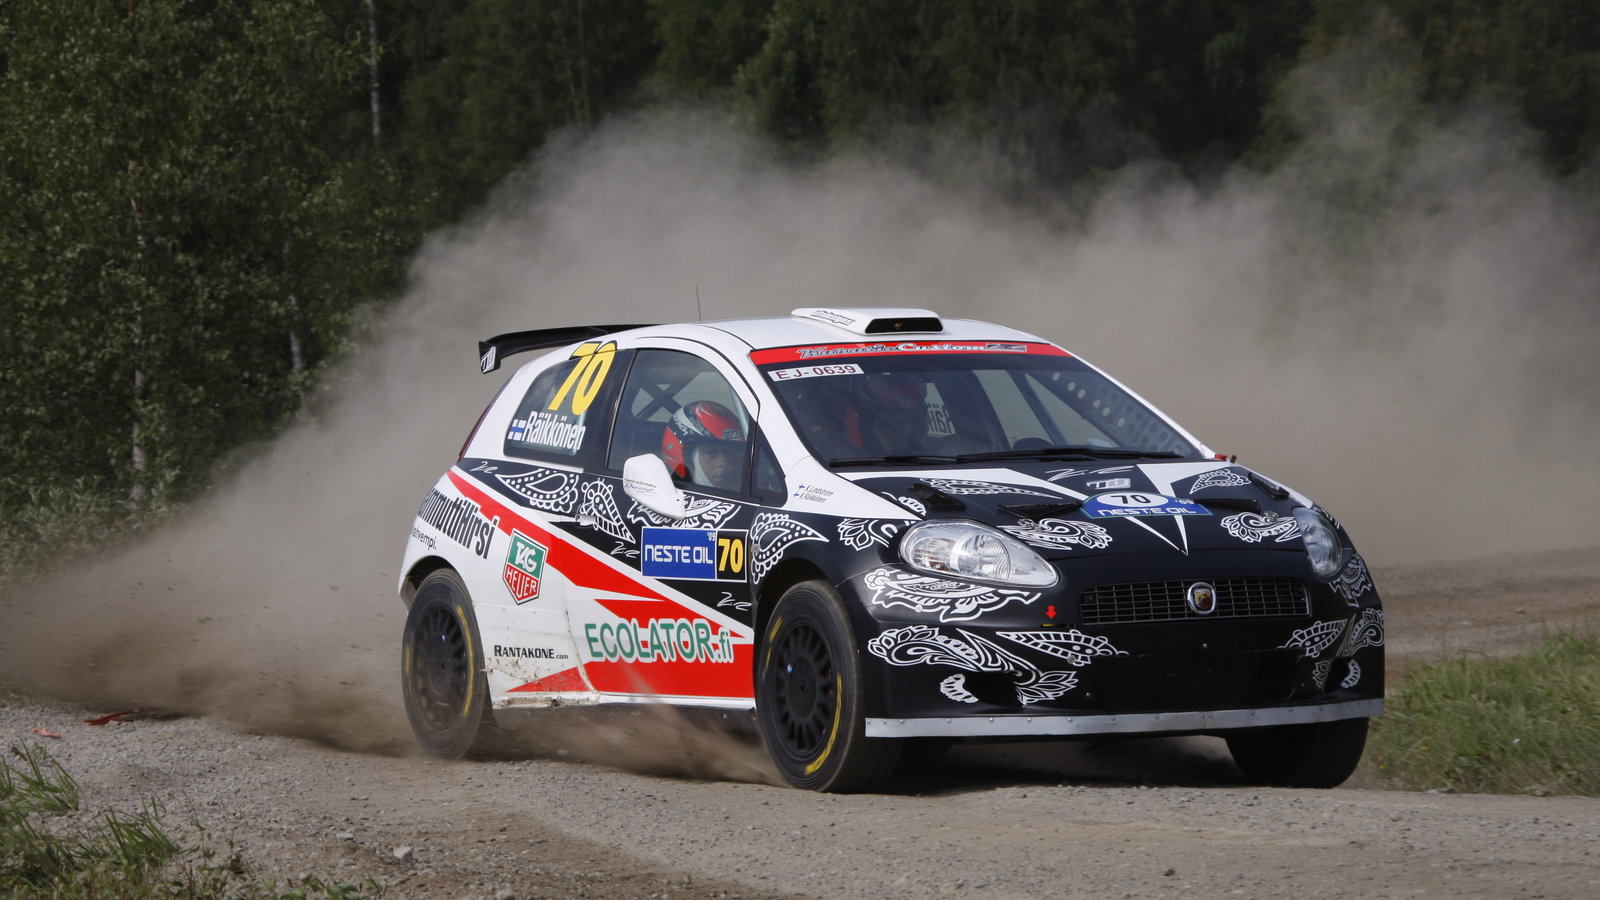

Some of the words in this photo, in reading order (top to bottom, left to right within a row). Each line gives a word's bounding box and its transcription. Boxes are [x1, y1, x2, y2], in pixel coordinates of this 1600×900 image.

[547, 340, 617, 415] 70
[522, 410, 586, 451] Räikkönen
[1097, 507, 1166, 516] NESTE
[1110, 494, 1151, 505] 70
[515, 541, 537, 573] TAG
[645, 544, 691, 563] NESTE
[693, 546, 713, 564] OIL
[718, 538, 744, 573] 70
[505, 566, 538, 601] HEUER
[584, 620, 734, 661] ECOLATOR.fi
